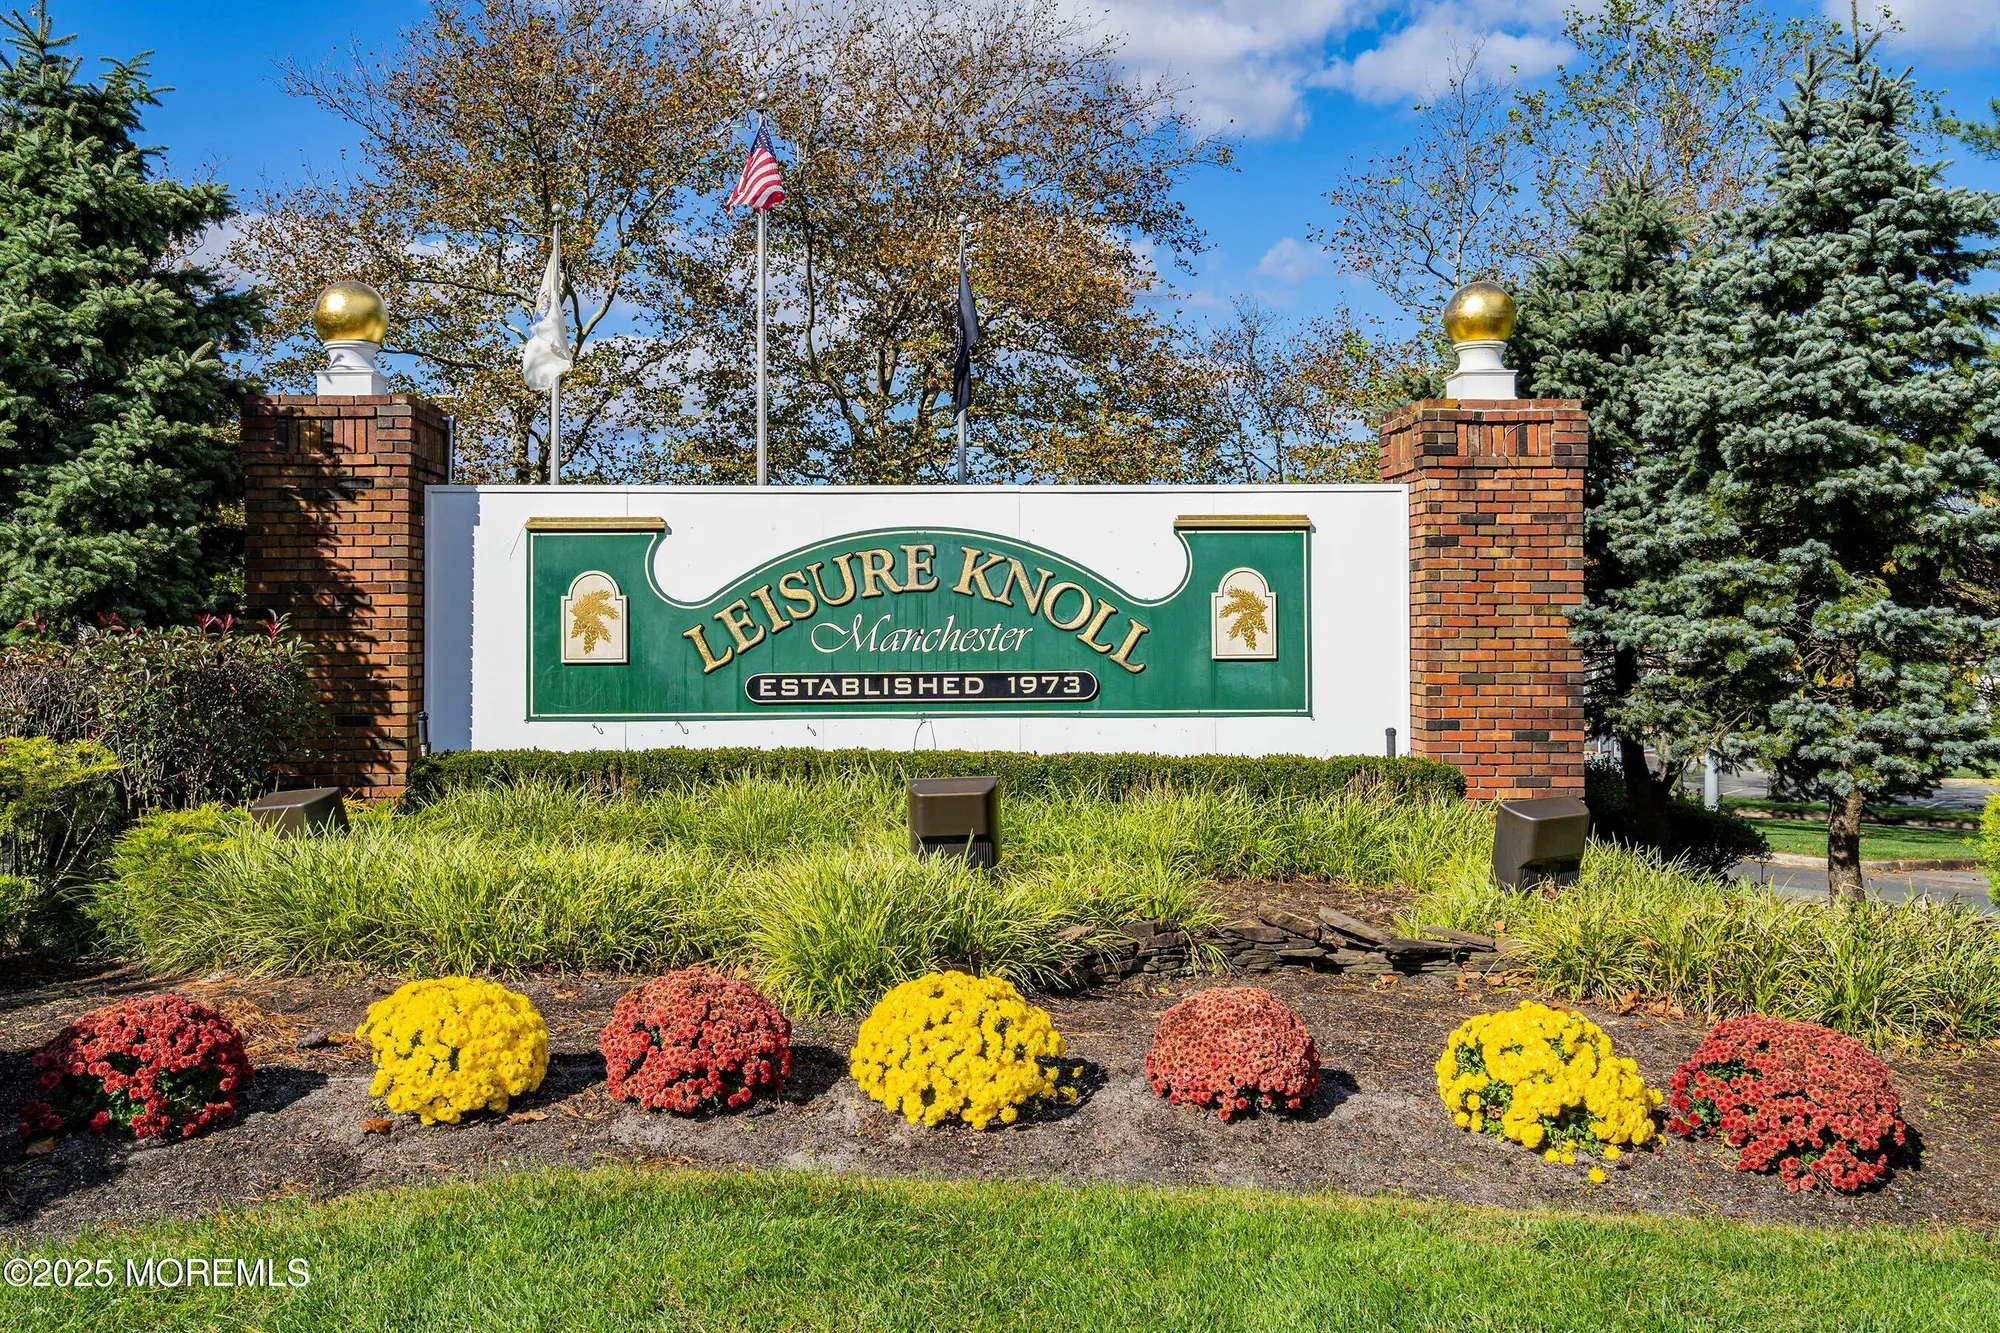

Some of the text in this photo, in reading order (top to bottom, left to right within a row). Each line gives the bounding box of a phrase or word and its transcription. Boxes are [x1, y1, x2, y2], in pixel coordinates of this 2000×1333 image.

[682, 543, 1151, 675] LEISURE KNOLL
[810, 612, 1034, 654] Manchester
[759, 675, 1081, 697] ESTABLISHED 1973
